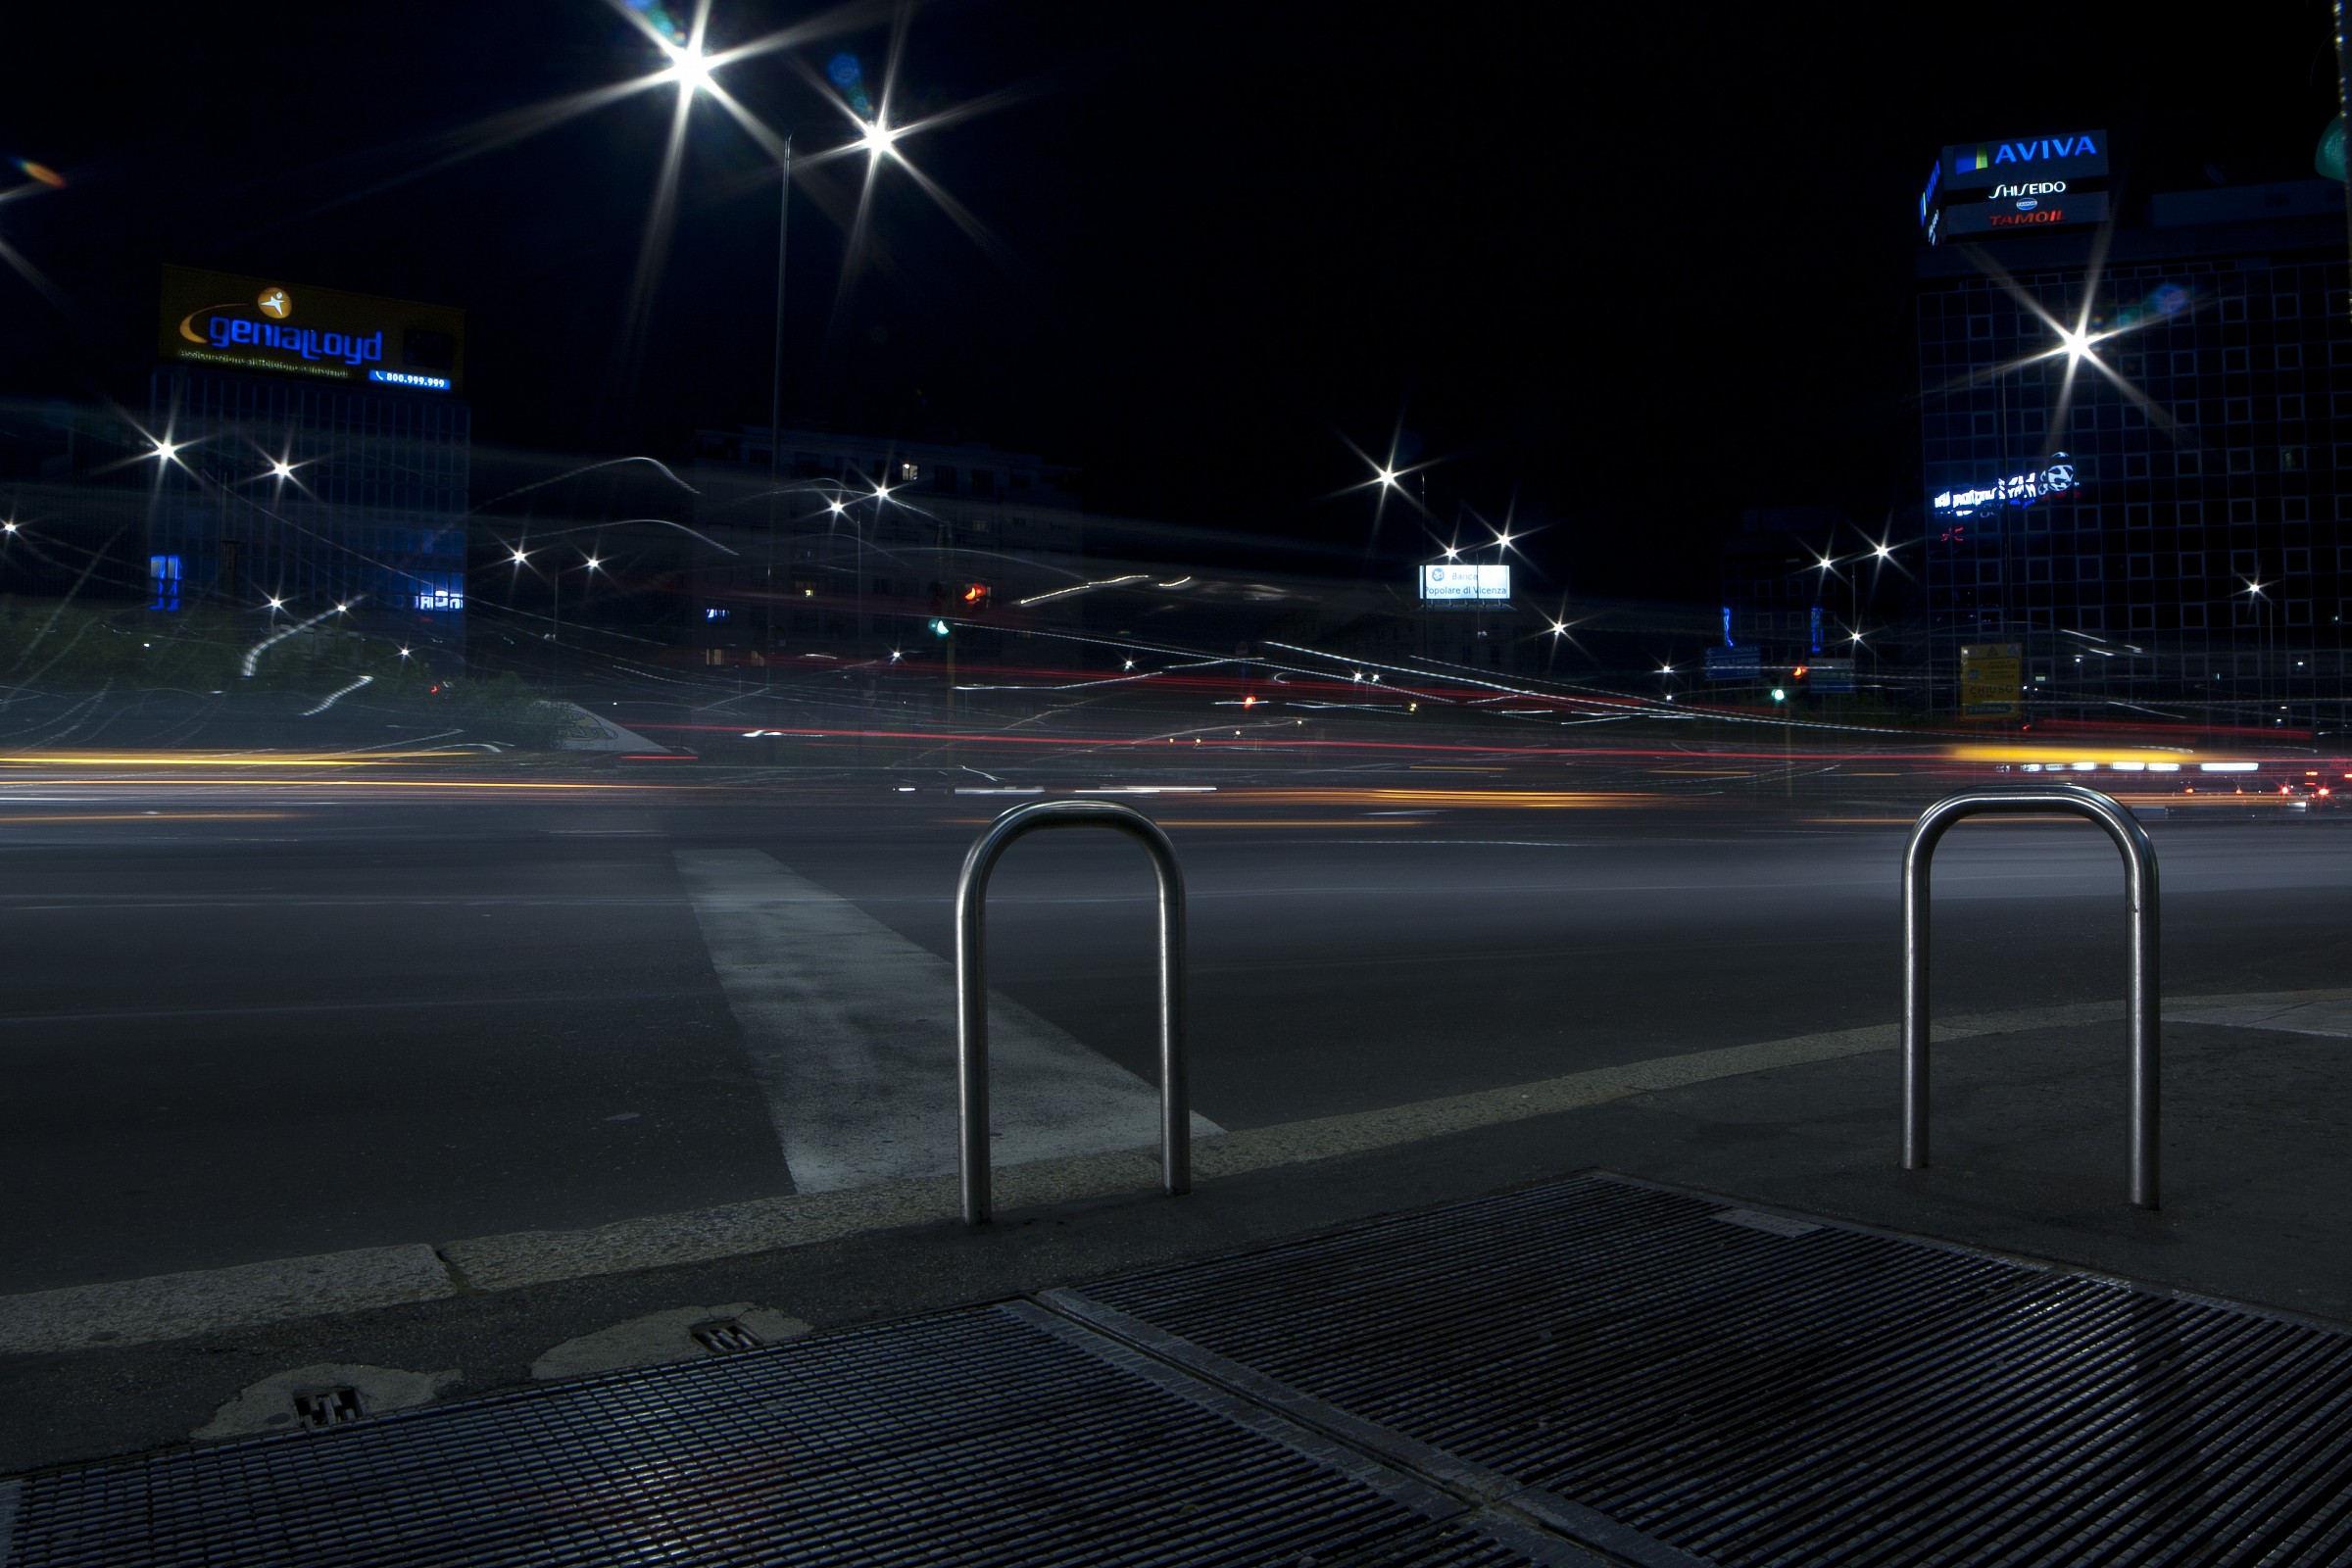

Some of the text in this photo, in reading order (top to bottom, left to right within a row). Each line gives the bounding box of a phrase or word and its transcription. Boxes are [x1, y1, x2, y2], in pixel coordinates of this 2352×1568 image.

[1994, 135, 2097, 165] AVIVA
[1987, 180, 2067, 200] SHISEIDO
[1988, 210, 2068, 227] TAMOIL
[386, 372, 445, 388] 800.999.999
[1451, 572, 1478, 581] Banca
[1473, 586, 1507, 595] Vicenza
[1969, 684, 2013, 695] CHIUSO
